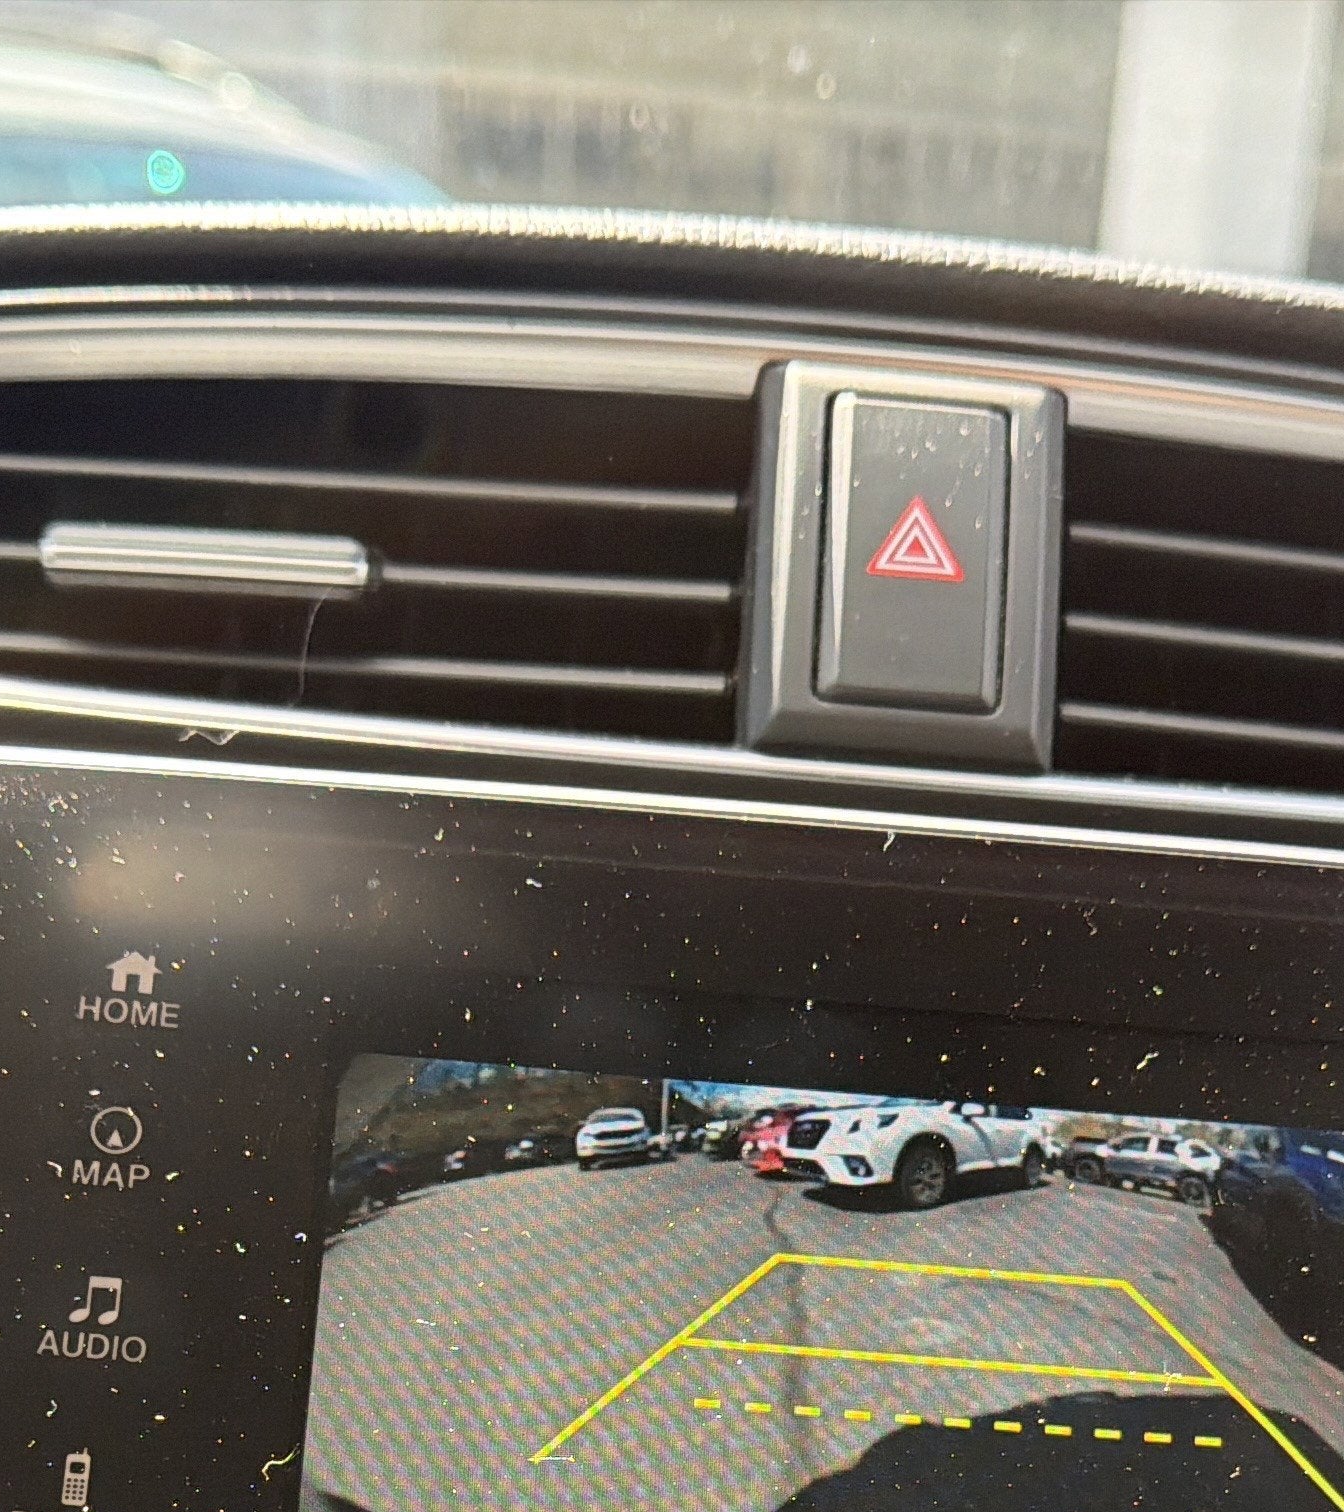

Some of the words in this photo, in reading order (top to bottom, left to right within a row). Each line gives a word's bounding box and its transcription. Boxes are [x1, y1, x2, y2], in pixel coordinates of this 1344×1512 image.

[78, 995, 181, 1029] HOME
[72, 1159, 151, 1189] MAP
[37, 1330, 147, 1363] AUDIO
